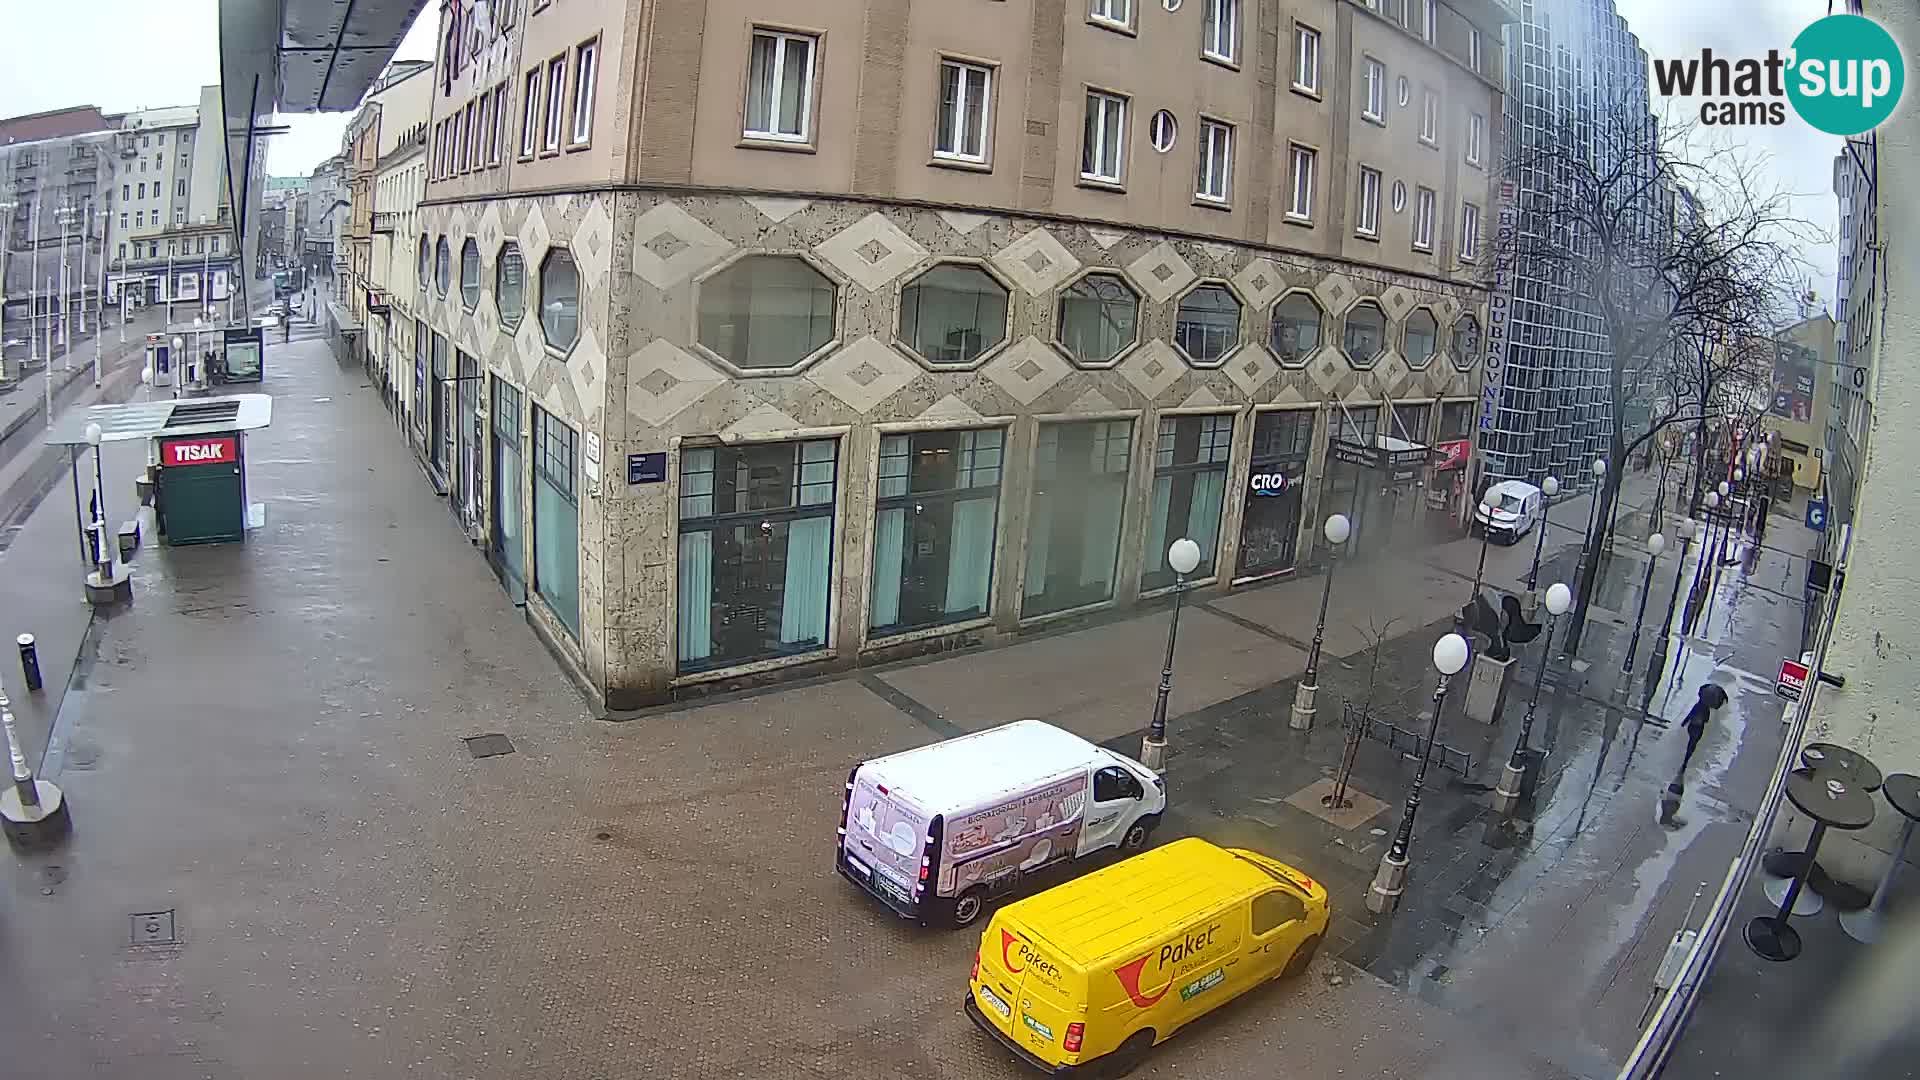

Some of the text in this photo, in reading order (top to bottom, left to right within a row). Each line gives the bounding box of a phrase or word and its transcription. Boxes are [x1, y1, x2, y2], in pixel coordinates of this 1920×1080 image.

[1480, 295, 1506, 430] DUBROVNIK
[174, 443, 223, 462] TISAK
[1251, 473, 1283, 490] CRO
[1158, 923, 1221, 971] Paket
